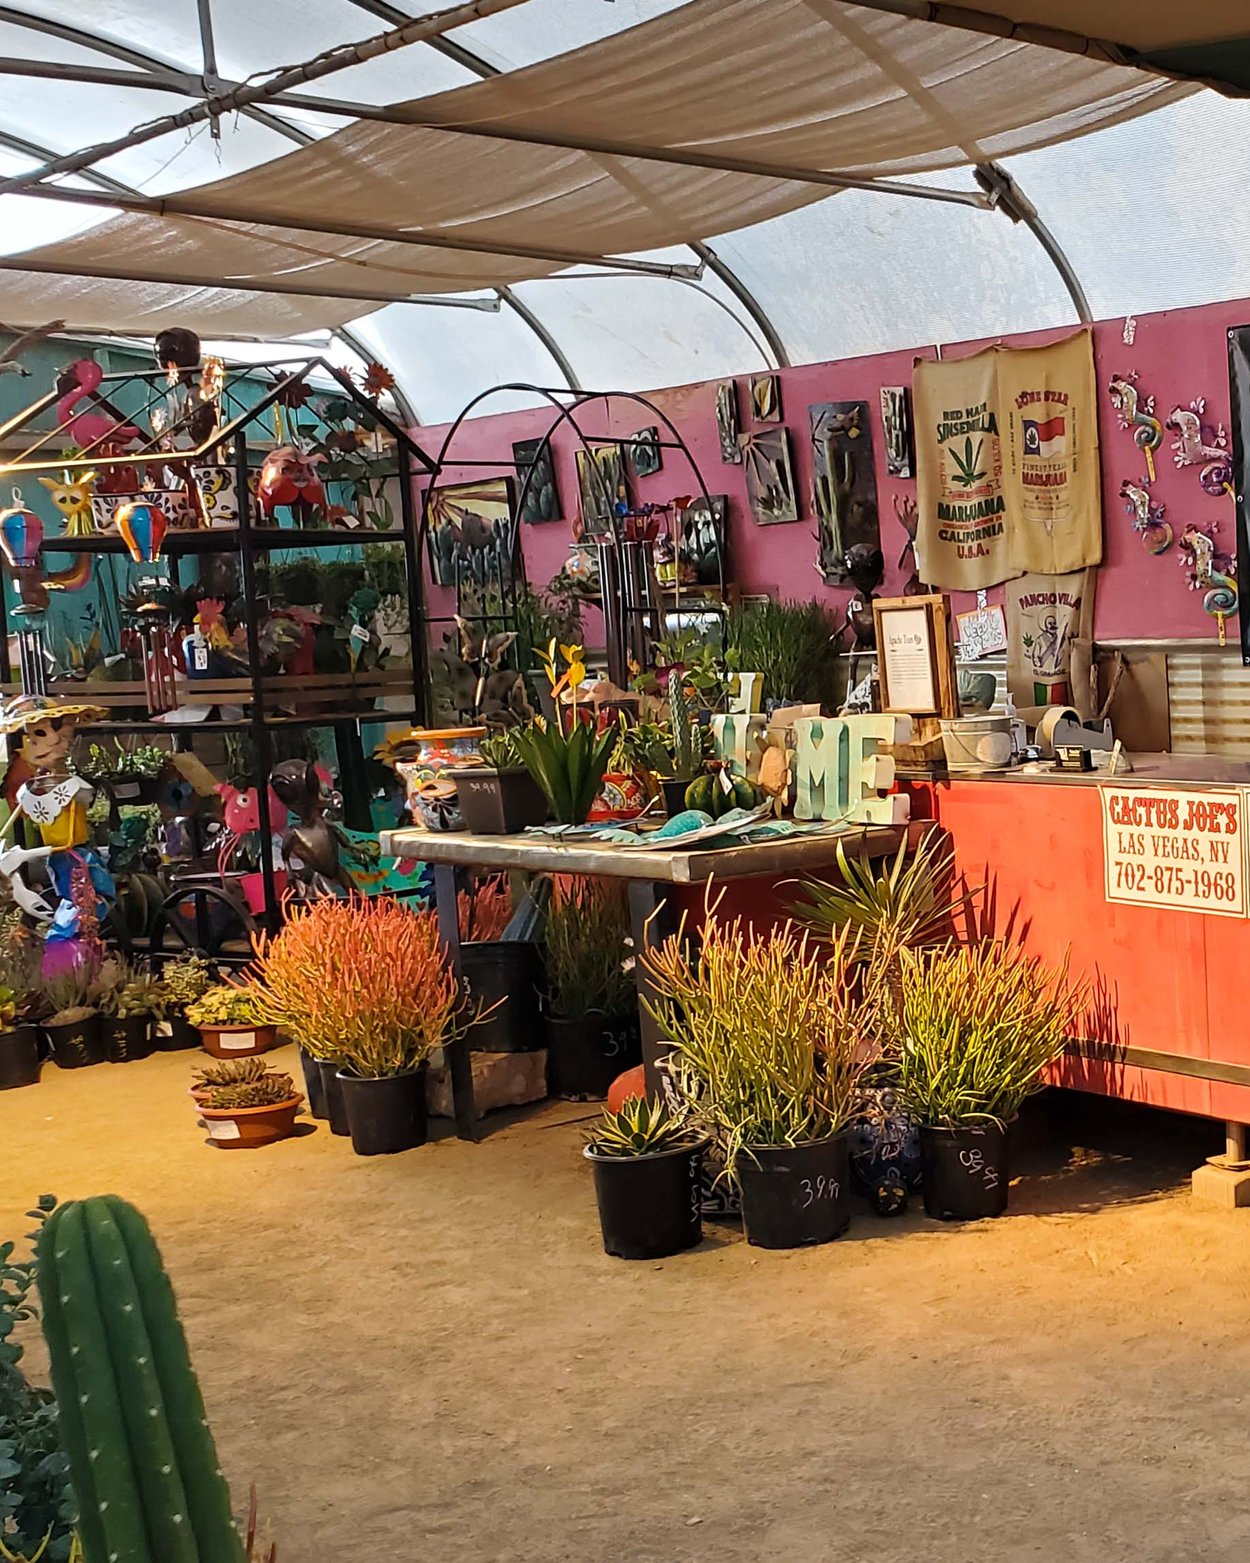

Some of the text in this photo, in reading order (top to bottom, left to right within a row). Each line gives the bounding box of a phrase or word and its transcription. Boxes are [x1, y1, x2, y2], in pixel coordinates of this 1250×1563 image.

[943, 411, 963, 421] RED
[938, 495, 1006, 523] MARIJUANA
[938, 523, 1004, 544] CALIFORNIA
[1019, 592, 1082, 611] PANCHO VILLA
[1109, 795, 1238, 835] CACTUS JOE'S
[1117, 831, 1230, 865] LAS VEGAS, NV
[1114, 861, 1236, 902] 702-875-1968
